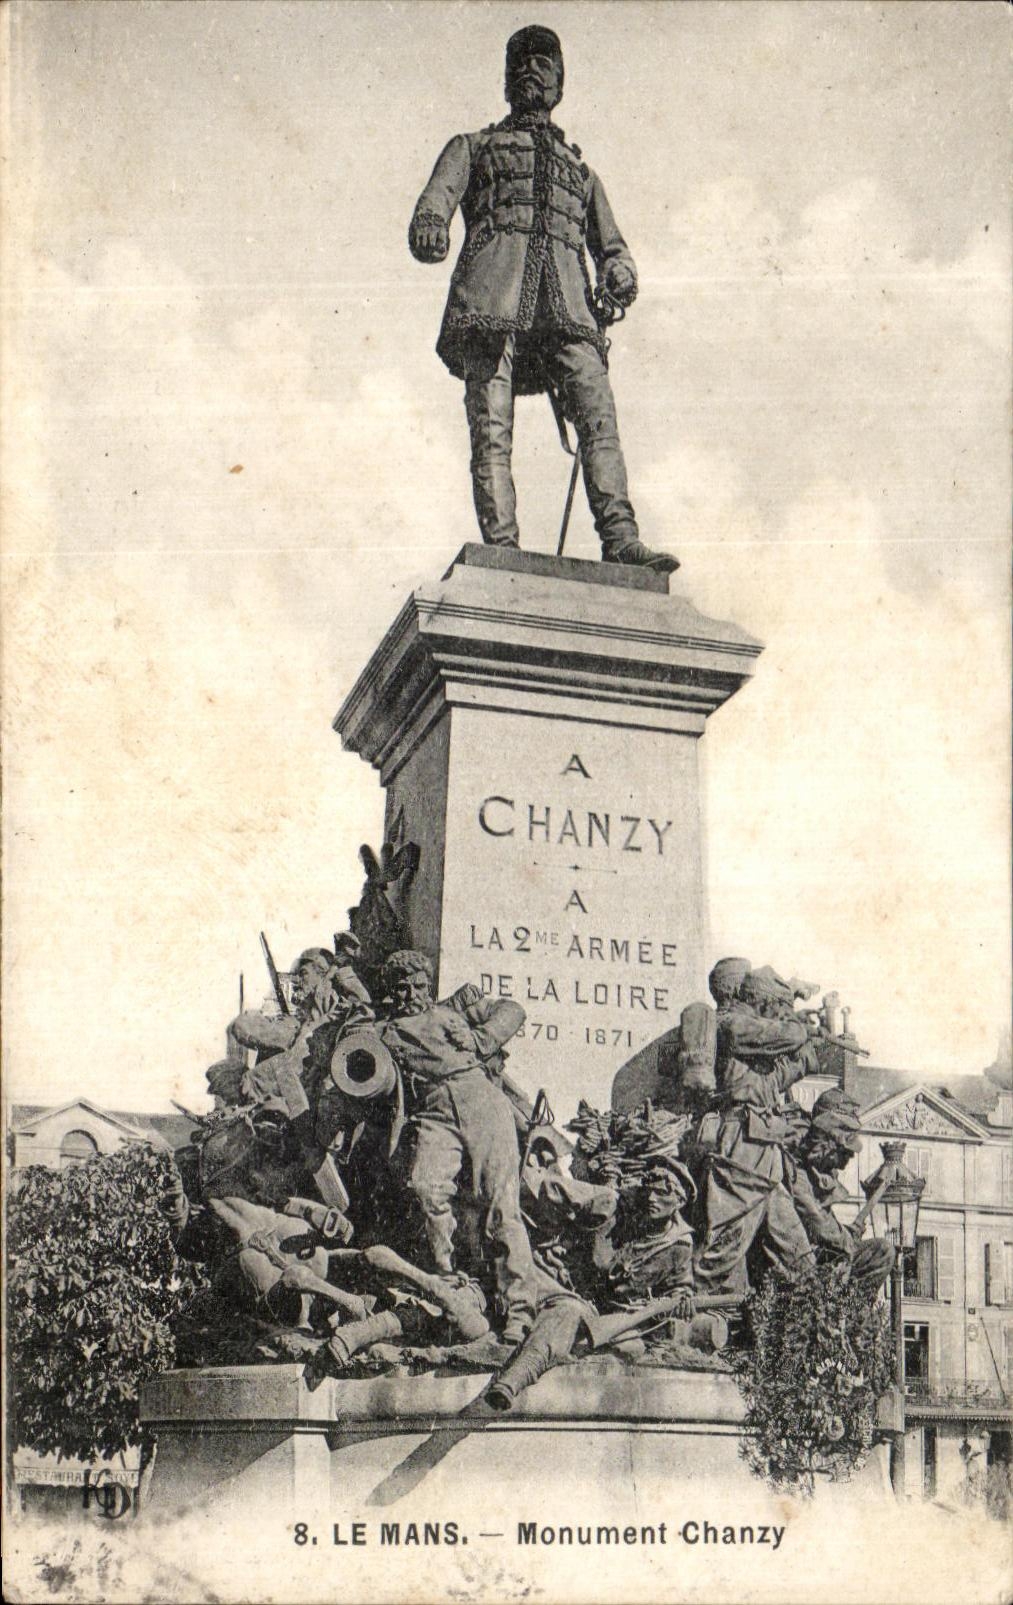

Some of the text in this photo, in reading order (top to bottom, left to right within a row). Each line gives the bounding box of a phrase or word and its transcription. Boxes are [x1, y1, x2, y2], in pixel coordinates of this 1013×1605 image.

[560, 753, 592, 779] A
[478, 795, 673, 855] CHANZY
[563, 889, 588, 914] A
[470, 925, 504, 951] LA
[566, 934, 677, 967] ARMÉE
[480, 973, 669, 1011] DE LA LOIRE
[585, 1027, 632, 1047] 1871
